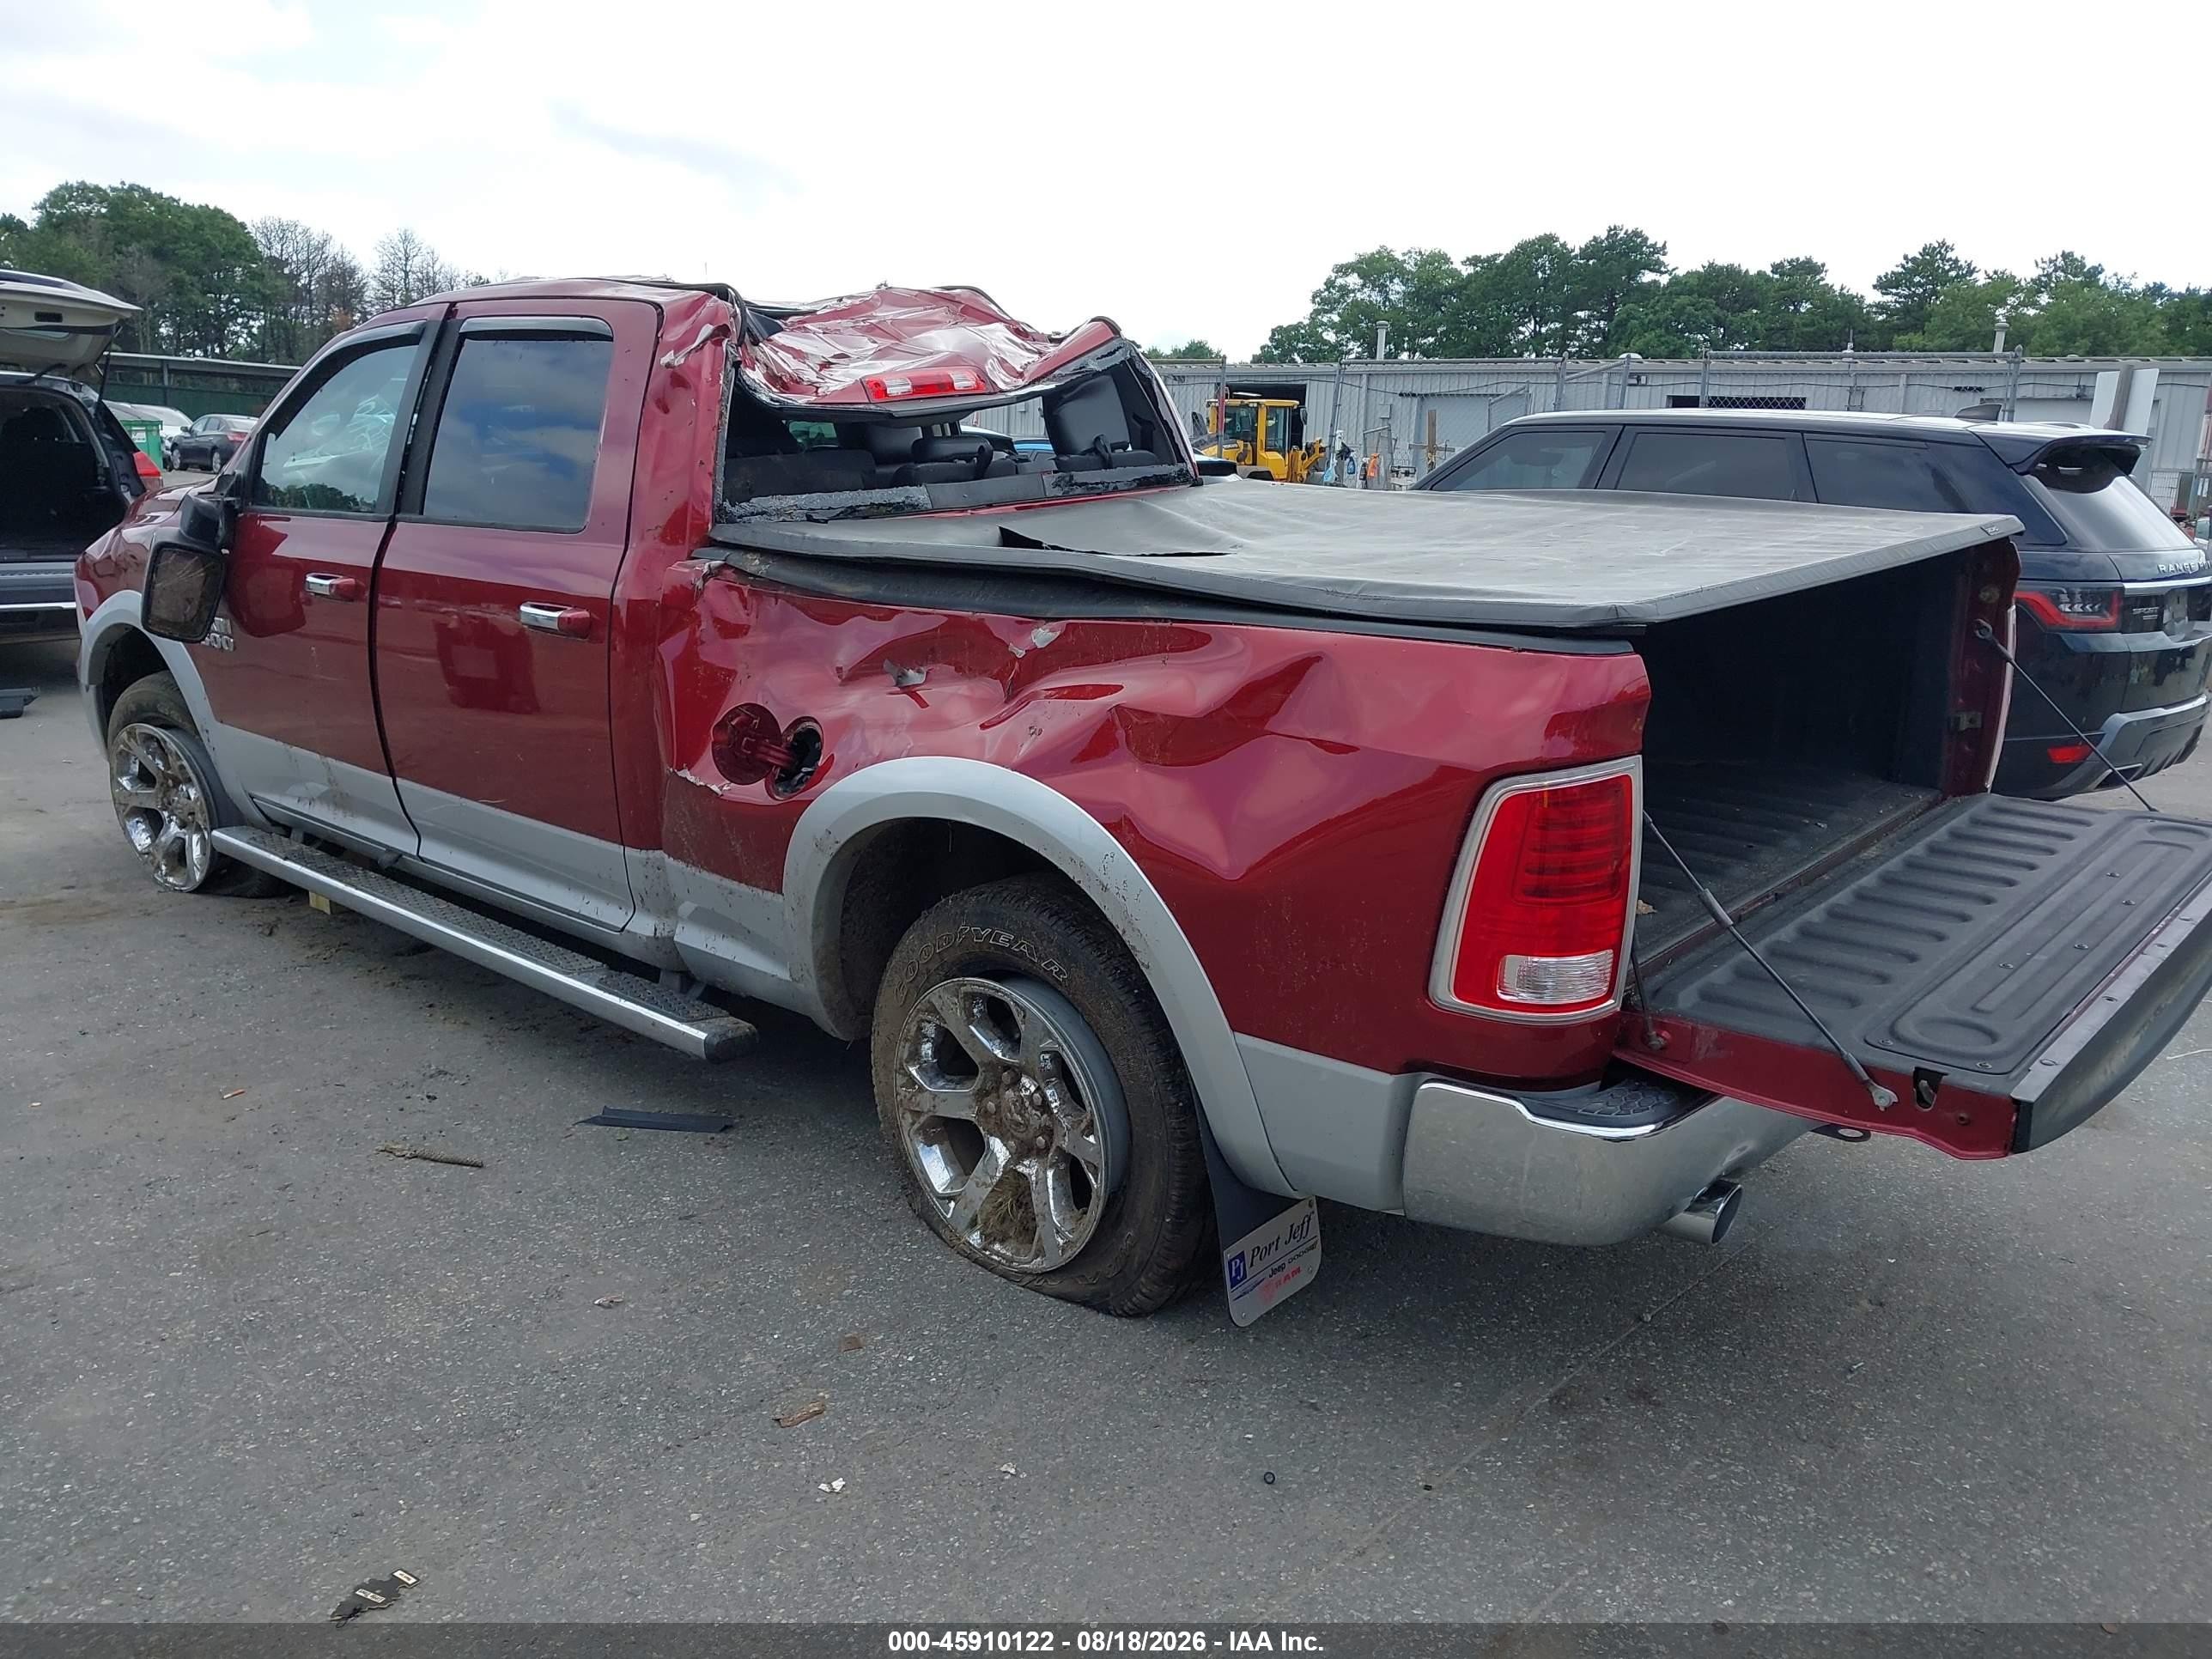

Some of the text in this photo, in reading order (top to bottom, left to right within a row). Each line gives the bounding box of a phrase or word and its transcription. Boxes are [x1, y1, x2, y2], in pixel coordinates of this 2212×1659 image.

[2156, 562, 2198, 574] RANGE
[1249, 1212, 1315, 1268] Port Jeff
[1231, 1258, 1245, 1279] PJ
[1268, 1262, 1286, 1279] Jeep
